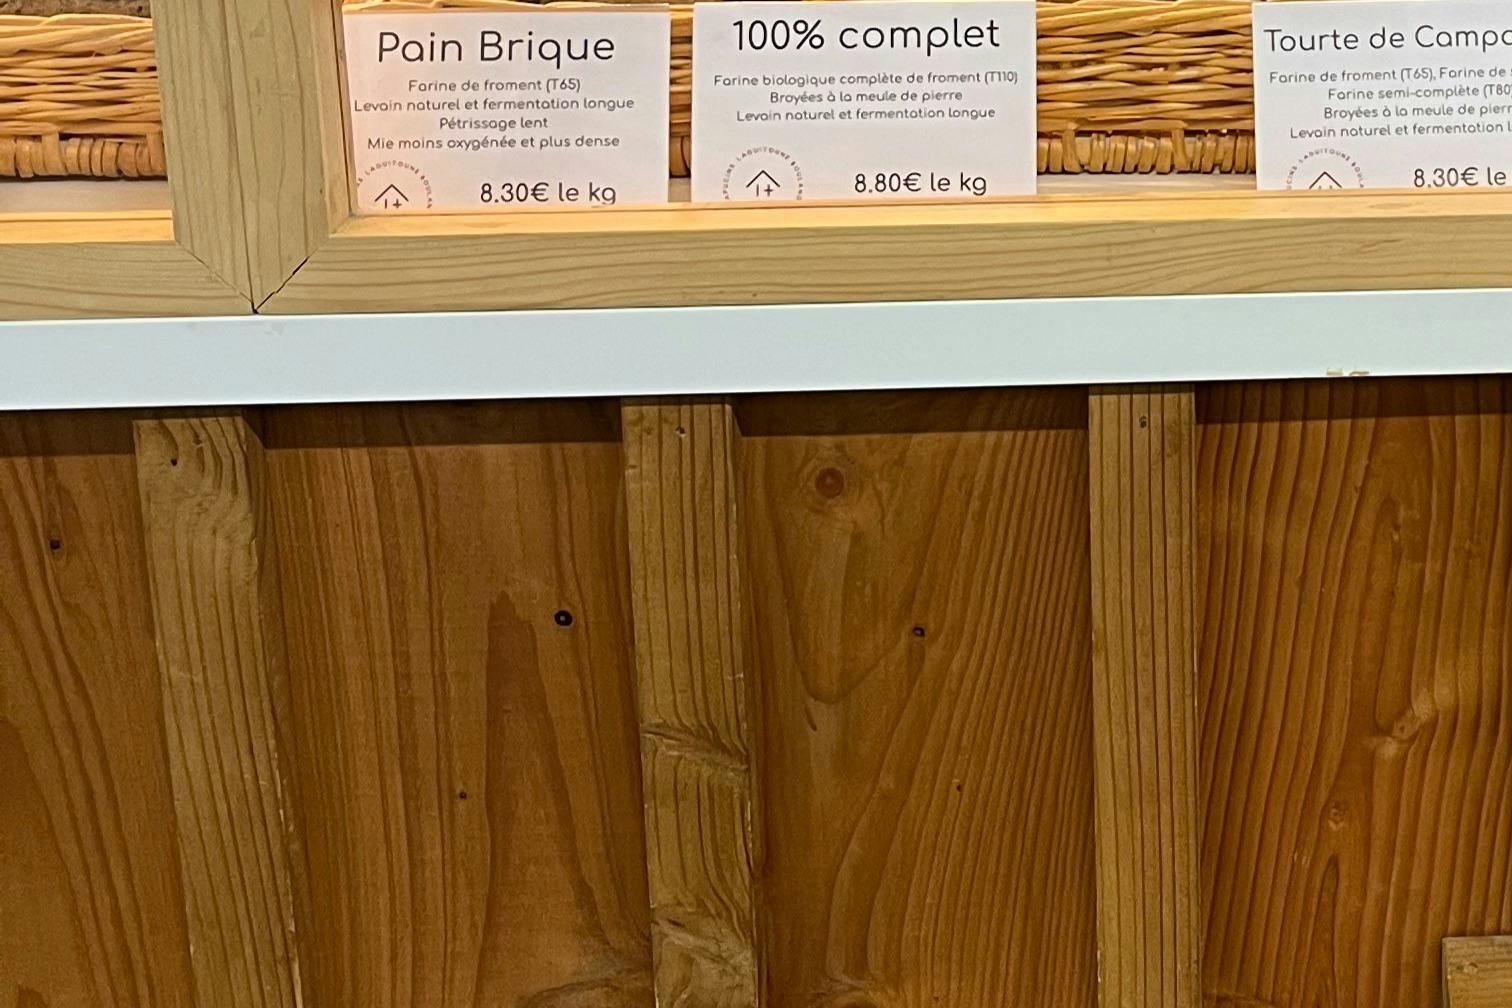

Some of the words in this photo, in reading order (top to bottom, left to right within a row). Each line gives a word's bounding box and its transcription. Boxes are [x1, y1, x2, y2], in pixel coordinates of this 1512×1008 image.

[733, 20, 824, 50] 100%
[839, 18, 1000, 57] complet
[1263, 29, 1358, 52] Tourte
[1369, 27, 1404, 49] de
[379, 32, 462, 62] Pain
[481, 31, 614, 70] Brique
[714, 75, 759, 86] Farine
[763, 74, 835, 88] biologique
[840, 72, 902, 87] complète
[907, 72, 923, 84] de
[927, 72, 981, 84] froment
[985, 71, 1017, 85] (T110)
[1270, 71, 1315, 83] Farine
[1320, 70, 1337, 82] de
[1341, 69, 1397, 81] froment
[1439, 65, 1485, 79] Farine
[1489, 66, 1506, 78] de
[409, 80, 456, 92] Farine
[461, 79, 479, 91] de
[484, 78, 542, 91] froment
[546, 78, 580, 94] (T65)
[1328, 88, 1374, 100] Farine
[1378, 84, 1479, 100] semi-complète
[354, 100, 402, 112] Levain
[407, 98, 460, 111] naturel
[465, 99, 478, 110] et
[483, 97, 579, 110] fermentation
[582, 97, 634, 112] longue
[770, 91, 823, 106] Broyées
[827, 90, 836, 102] à
[840, 91, 852, 102] la
[856, 90, 897, 102] meule
[901, 90, 918, 101] de
[922, 89, 962, 104] pierre
[737, 109, 781, 121] Levain
[785, 109, 834, 120] naturel
[839, 110, 852, 119] et
[856, 107, 945, 119] fermentation
[948, 107, 995, 120] longue
[1324, 105, 1378, 122] Broyées
[1383, 105, 1391, 117] à
[1395, 105, 1408, 117] la
[1412, 104, 1454, 116] meule
[1458, 103, 1475, 115] de
[440, 116, 516, 132] Pétrissage
[520, 116, 548, 128] lent
[1291, 127, 1336, 139] Levain
[1341, 124, 1391, 137] naturel
[1395, 125, 1408, 135] et
[1413, 121, 1503, 134] fermentation
[368, 137, 394, 149] Mie
[399, 137, 443, 149] moins
[447, 135, 516, 151] oxygénée
[521, 137, 535, 147] et
[540, 136, 571, 150] plus
[575, 135, 619, 147] dense
[855, 172, 921, 193] 8.80€
[931, 172, 950, 191] le
[960, 172, 986, 196] kg
[1414, 167, 1478, 188] 8.30€
[1487, 167, 1506, 185] le
[481, 182, 549, 203] 8.30€
[559, 182, 579, 201] le
[589, 182, 616, 204] kg
